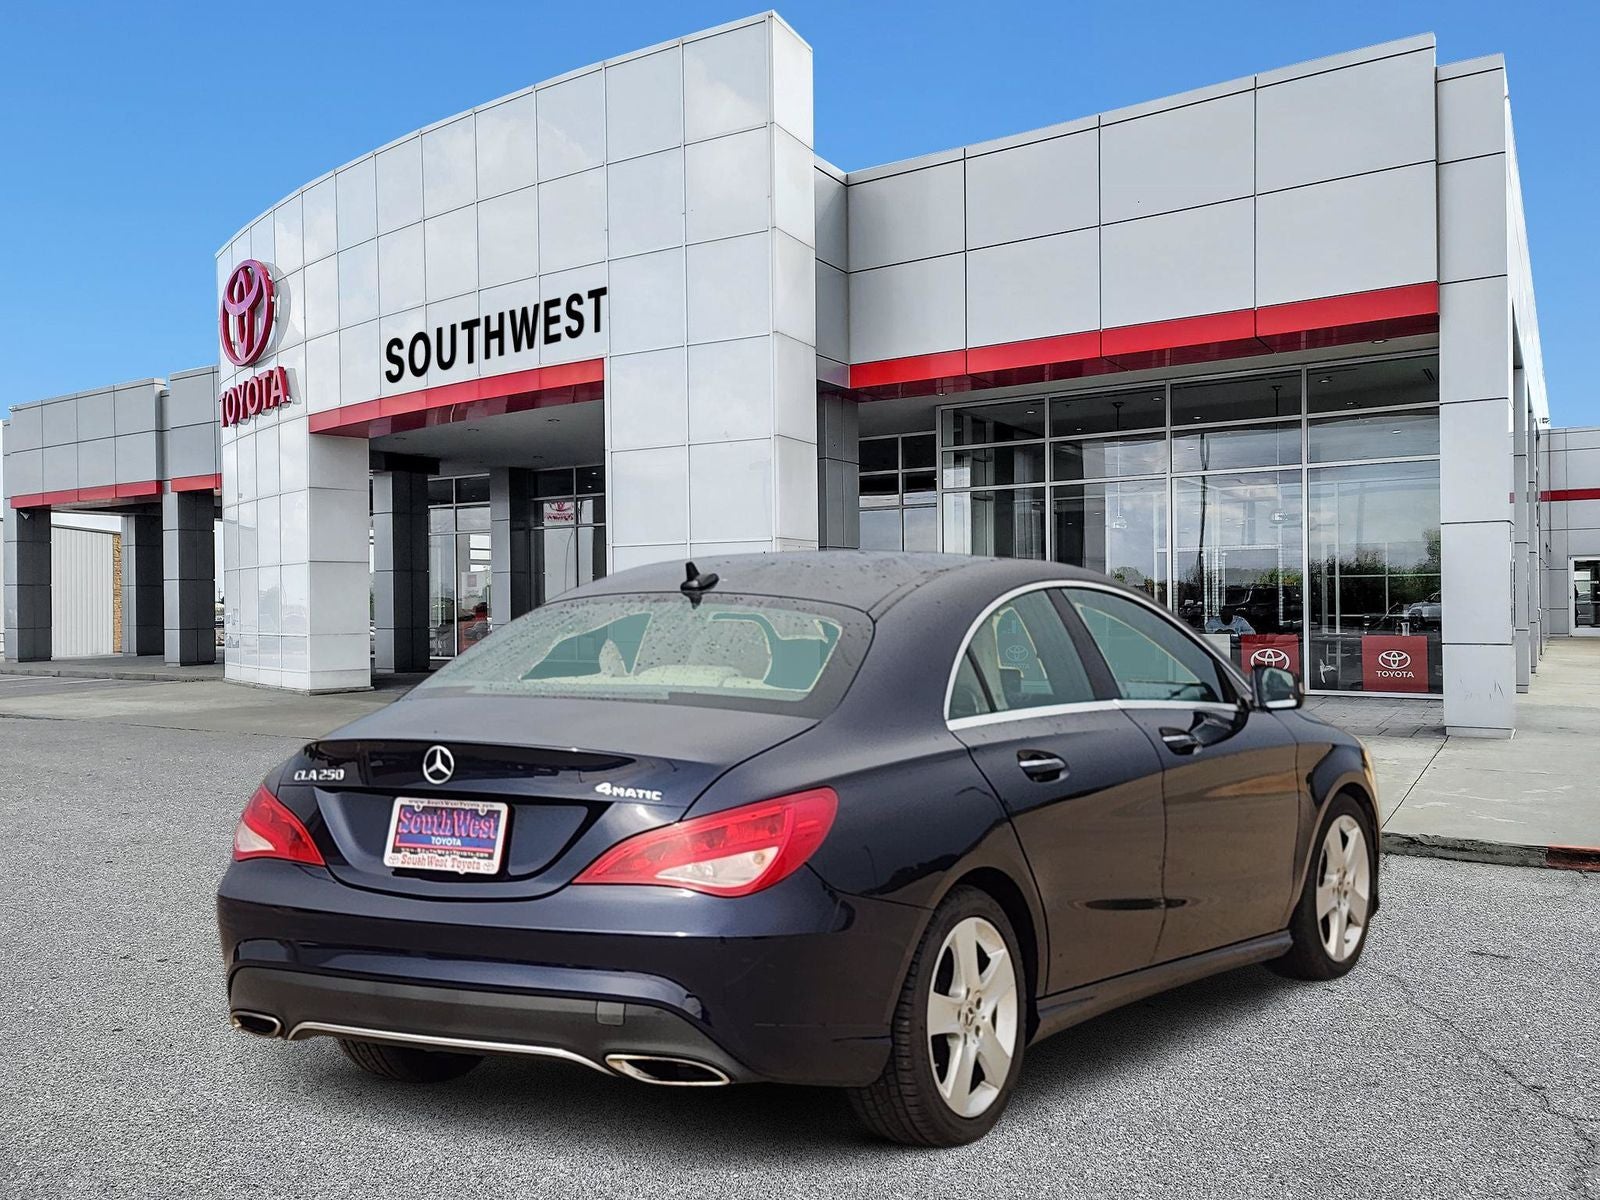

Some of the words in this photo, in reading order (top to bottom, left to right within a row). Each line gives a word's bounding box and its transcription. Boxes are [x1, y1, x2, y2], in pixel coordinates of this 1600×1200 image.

[385, 286, 608, 384] SOUTHWEST
[219, 366, 291, 427] TOYOTA
[1376, 670, 1415, 678] TOYOTA
[294, 769, 317, 781] CLA
[318, 769, 345, 781] 250
[595, 782, 663, 801] 4MATIC
[431, 836, 462, 846] TOYOTA
[451, 857, 481, 871] Toyota
